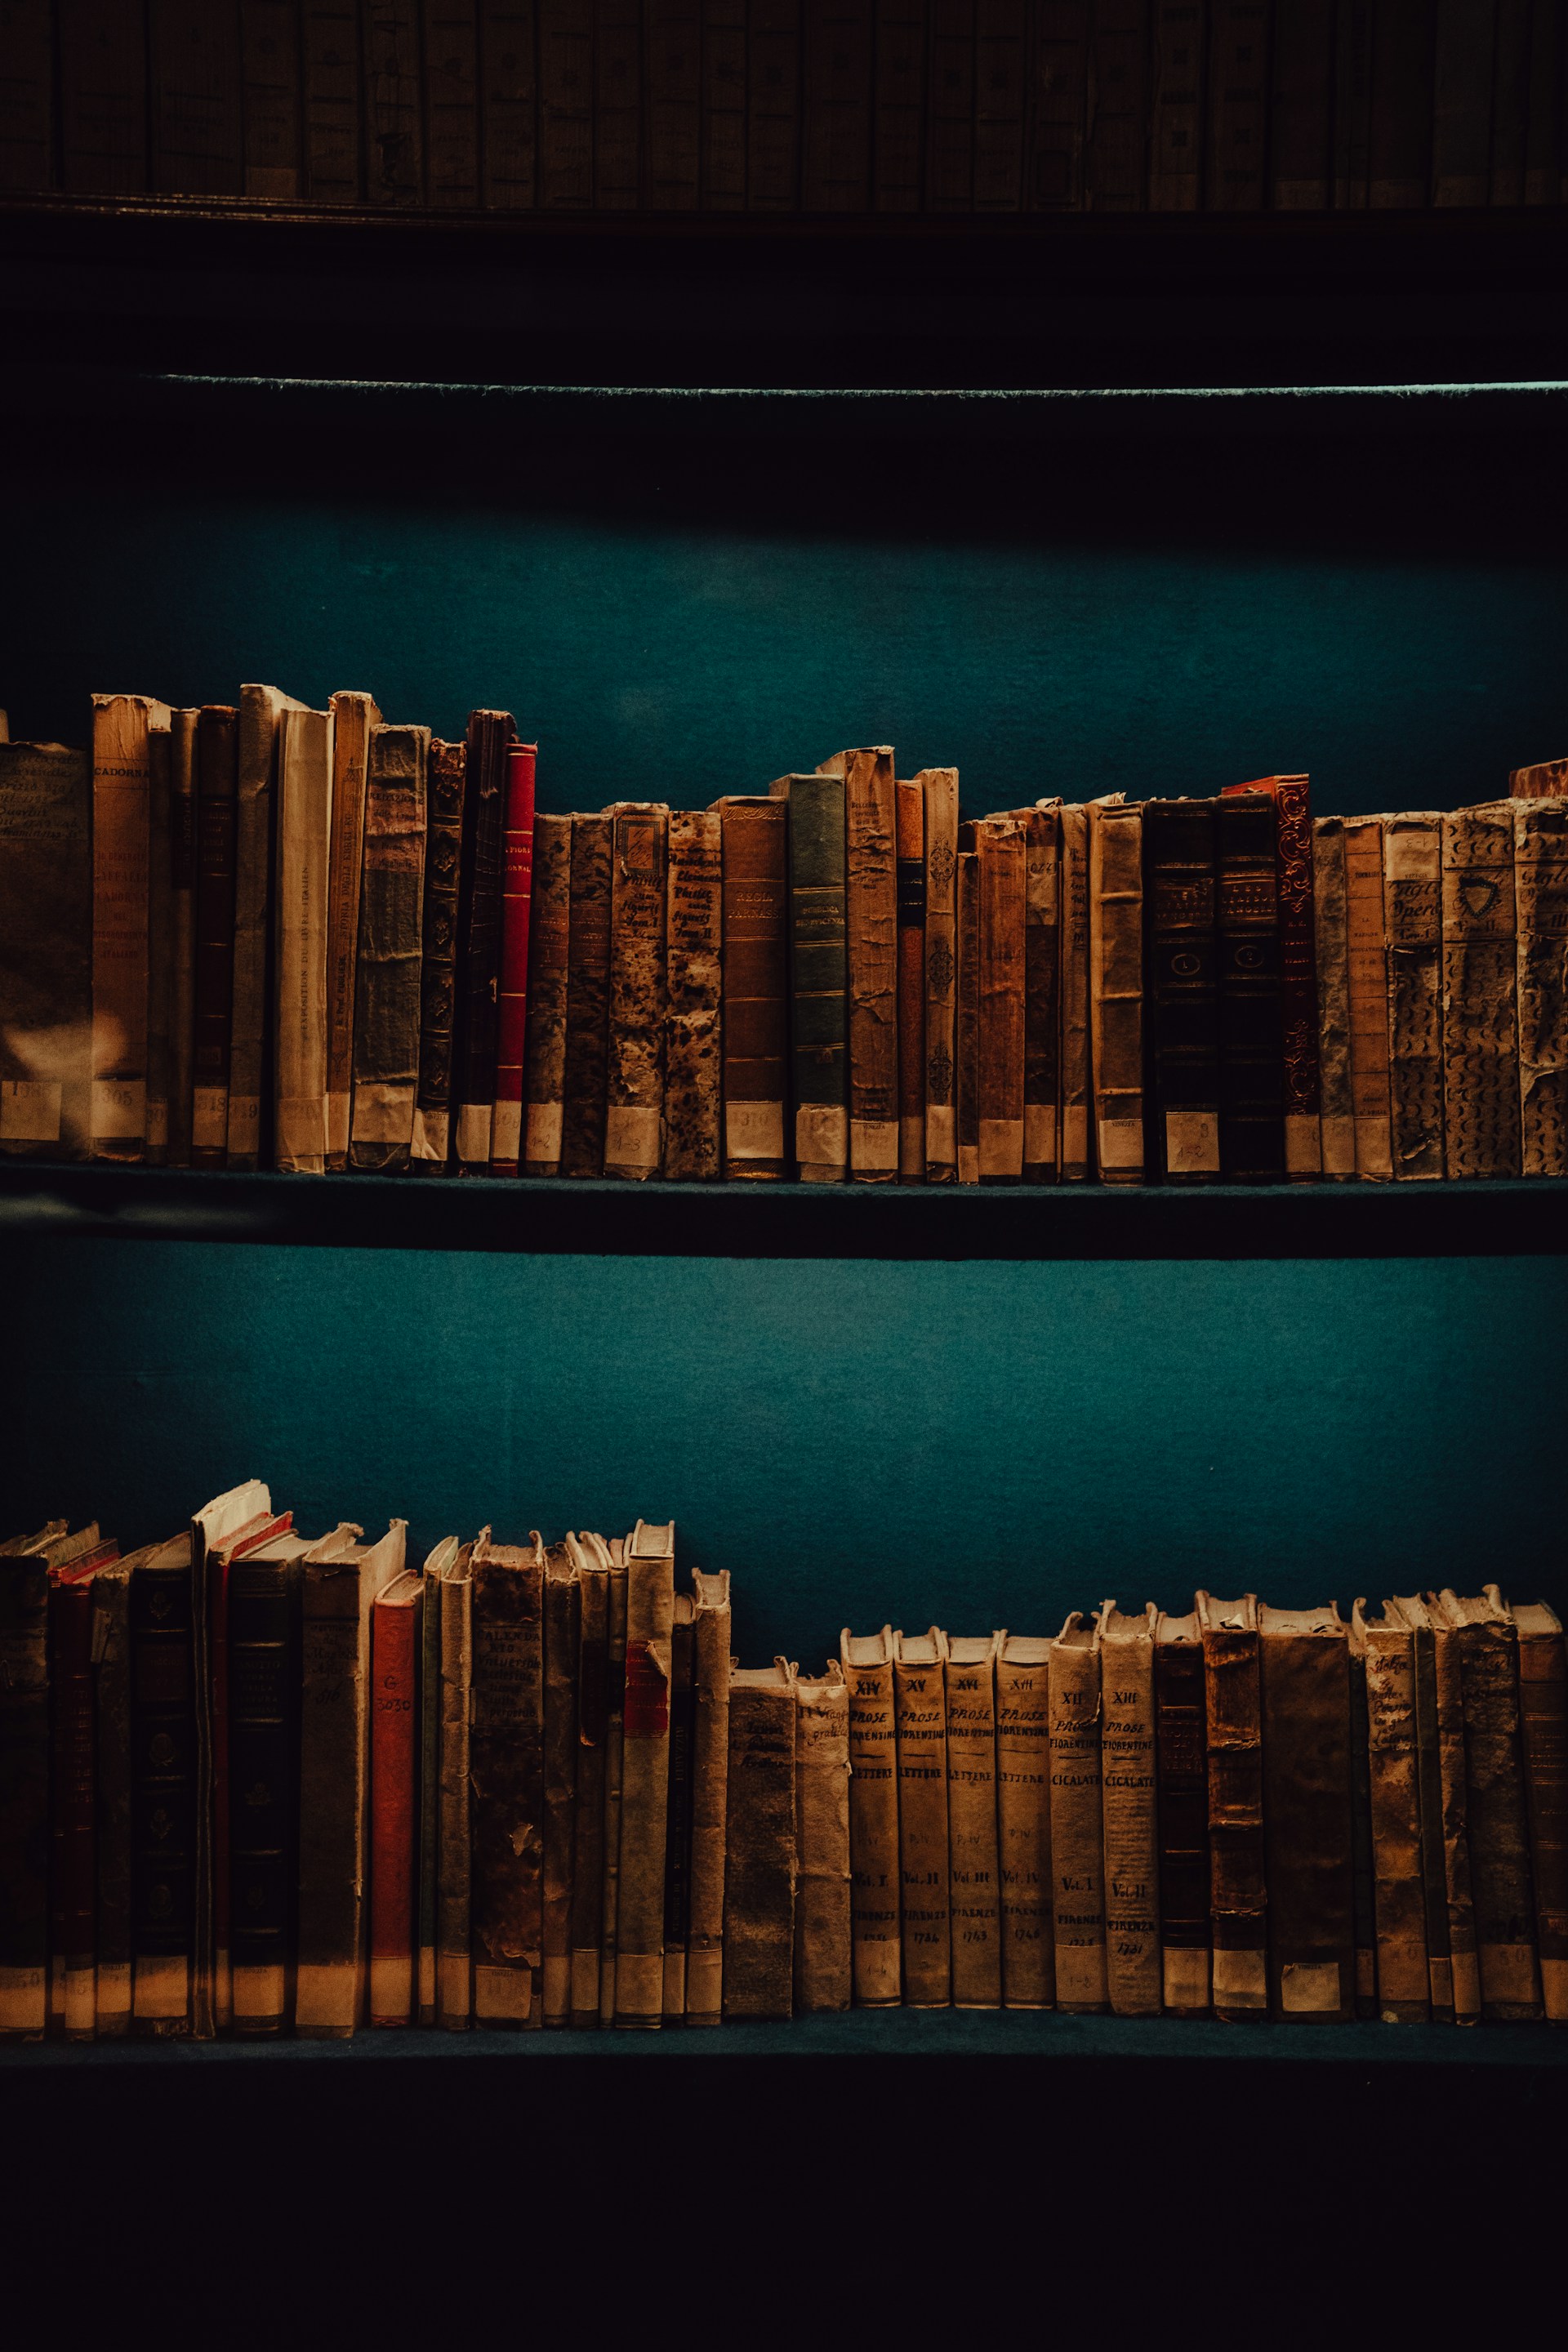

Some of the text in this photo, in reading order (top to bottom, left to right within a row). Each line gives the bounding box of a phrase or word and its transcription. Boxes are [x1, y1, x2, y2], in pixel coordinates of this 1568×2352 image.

[94, 767, 149, 777] CADORNA
[856, 1679, 882, 1695] XIV
[906, 1678, 927, 1693] XV
[956, 1678, 979, 1691] XVI
[1062, 1691, 1082, 1705] XII
[1112, 1691, 1138, 1704] XIII
[850, 1709, 889, 1724] PROSE
[898, 1711, 942, 1723] PROSE
[948, 1708, 991, 1722] PROSE
[999, 1708, 1046, 1722] PROSE
[1105, 1722, 1146, 1734] PROSE
[949, 1769, 992, 1781] LETTERE
[998, 1772, 1045, 1784] LETTERE
[1052, 1775, 1100, 1786] CICALATE
[1104, 1775, 1156, 1788] CICALATE
[974, 1872, 990, 1883] III
[951, 1907, 996, 1918] FIRENZE
[1058, 1915, 1101, 1925] FIRENZE
[1107, 1920, 1155, 1932] FIRENZE
